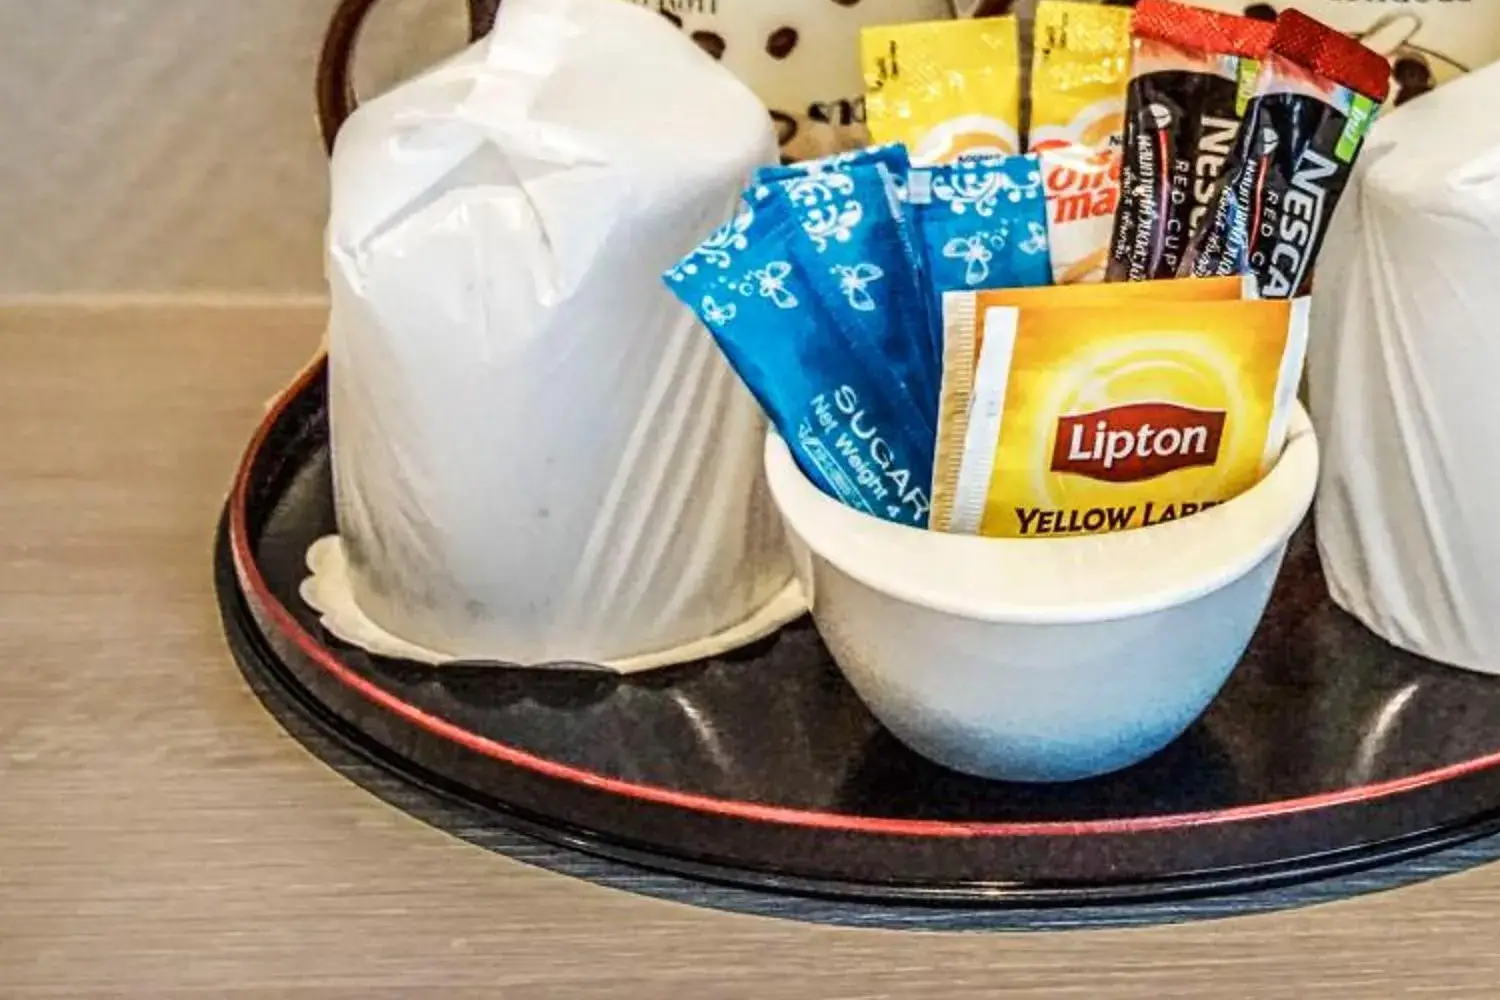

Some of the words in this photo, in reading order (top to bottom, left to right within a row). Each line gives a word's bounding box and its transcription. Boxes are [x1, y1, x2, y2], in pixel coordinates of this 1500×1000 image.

[1171, 159, 1190, 205] RED
[1260, 191, 1280, 238] RED
[1163, 218, 1182, 269] CUP
[810, 393, 839, 435] Net
[835, 432, 889, 501] Weight
[834, 384, 930, 521] SUGAR
[1067, 419, 1208, 469] Lipton
[1014, 505, 1137, 535] YELLOW
